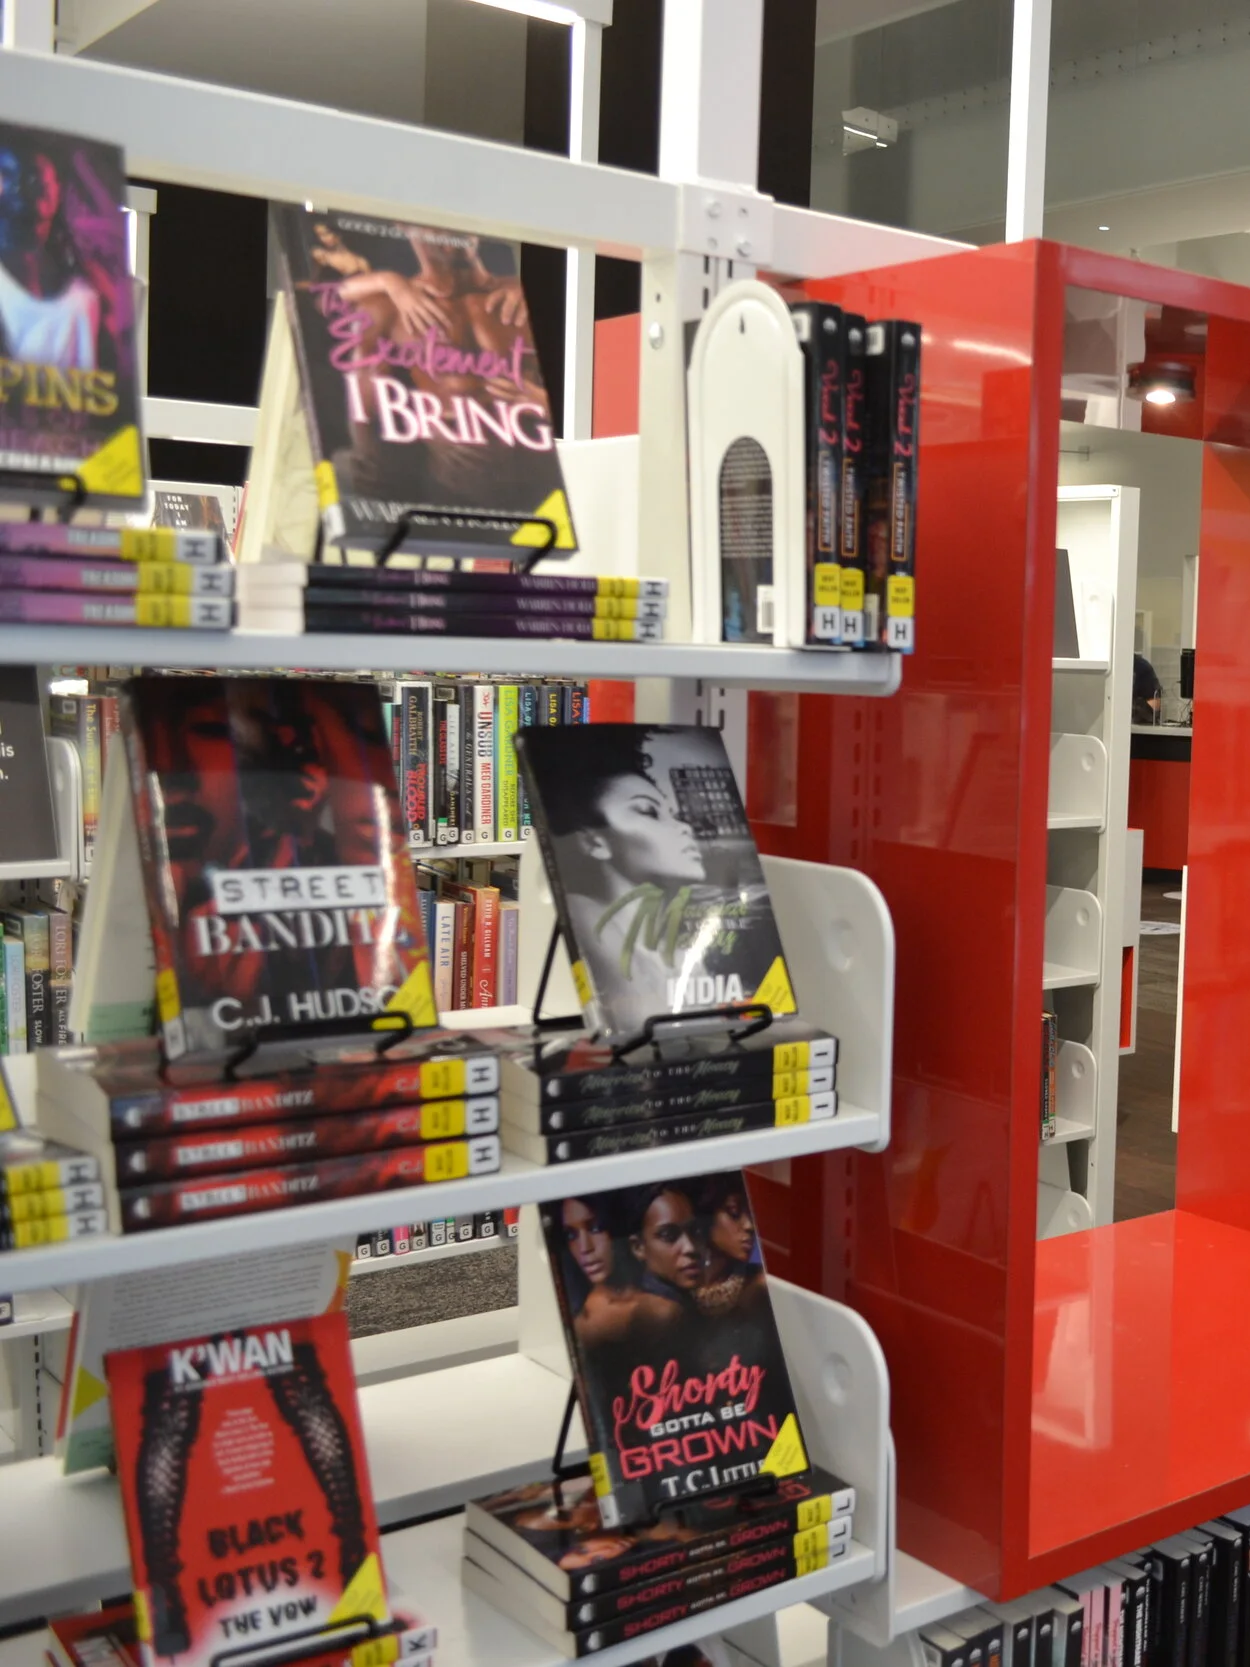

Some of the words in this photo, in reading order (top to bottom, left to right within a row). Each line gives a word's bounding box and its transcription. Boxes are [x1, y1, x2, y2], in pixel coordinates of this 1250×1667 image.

[343, 374, 369, 424] I
[374, 374, 557, 452] BRING
[164, 503, 190, 511] TODAY
[844, 617, 857, 633] H
[895, 624, 908, 641] H
[503, 689, 514, 716] LISA
[524, 692, 532, 713] LISA
[549, 693, 557, 714] LISA
[571, 691, 582, 719] LISA
[478, 711, 493, 758] UNSUB
[503, 719, 513, 776] GARDNER
[481, 762, 491, 780] MEG
[480, 783, 491, 825] GARDINER
[413, 832, 421, 841] G
[481, 831, 489, 840] G
[504, 830, 512, 839] G
[523, 828, 531, 836] G
[221, 871, 384, 904] STREET
[440, 915, 451, 943] LATE
[440, 947, 450, 968] AIR
[31, 967, 44, 1014] FOSTER
[54, 958, 68, 1004] FOSTER
[666, 972, 745, 1007] INDIA
[290, 987, 400, 1024] HUDSO
[33, 1019, 43, 1045] SLOW
[470, 1065, 491, 1084] H
[475, 1144, 493, 1164] H
[435, 1234, 443, 1242] G
[462, 1228, 470, 1237] G
[484, 1226, 492, 1234] G
[510, 1226, 518, 1234] G
[380, 1243, 388, 1251] G
[170, 1328, 295, 1384] K'WAN
[612, 1354, 767, 1431] Shorty
[650, 1411, 716, 1438] GOTTA
[719, 1402, 747, 1421] BE
[837, 1496, 851, 1512] L
[207, 1508, 305, 1558] BLACK
[197, 1560, 294, 1607] LOTUS
[305, 1550, 326, 1582] 2
[618, 1551, 687, 1580] SHORTY
[218, 1609, 266, 1638] THE
[270, 1595, 318, 1628] VOW
[622, 1603, 690, 1637] SHORTY
[407, 1635, 430, 1652] K
